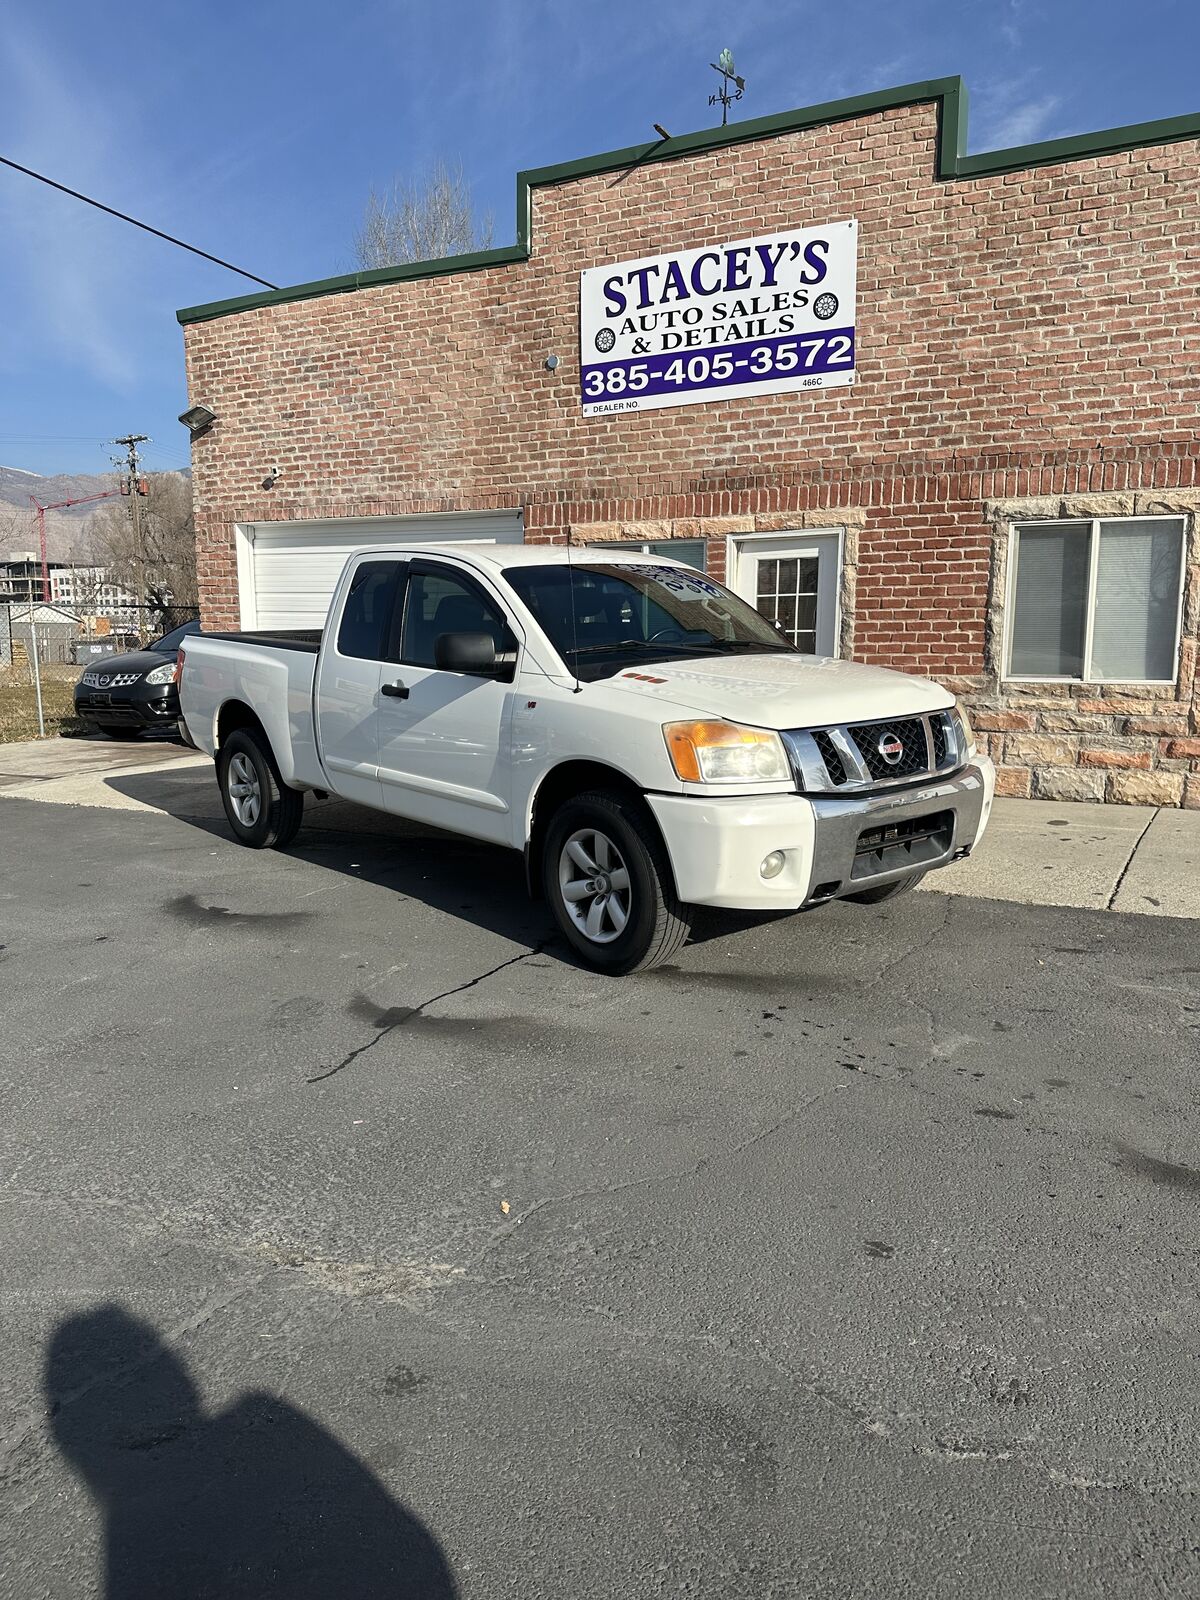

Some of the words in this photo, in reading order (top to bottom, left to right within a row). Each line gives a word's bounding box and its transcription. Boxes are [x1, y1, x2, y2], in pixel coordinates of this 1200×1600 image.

[603, 239, 830, 318] STACEY'S
[619, 307, 704, 335] AUTO
[711, 289, 809, 321] SALES
[631, 336, 652, 355] &
[660, 314, 795, 351] DETAILS
[584, 335, 852, 396] 385-405-3572
[593, 402, 624, 413] DEALER
[626, 400, 640, 410] NO.
[802, 377, 823, 387] 466C
